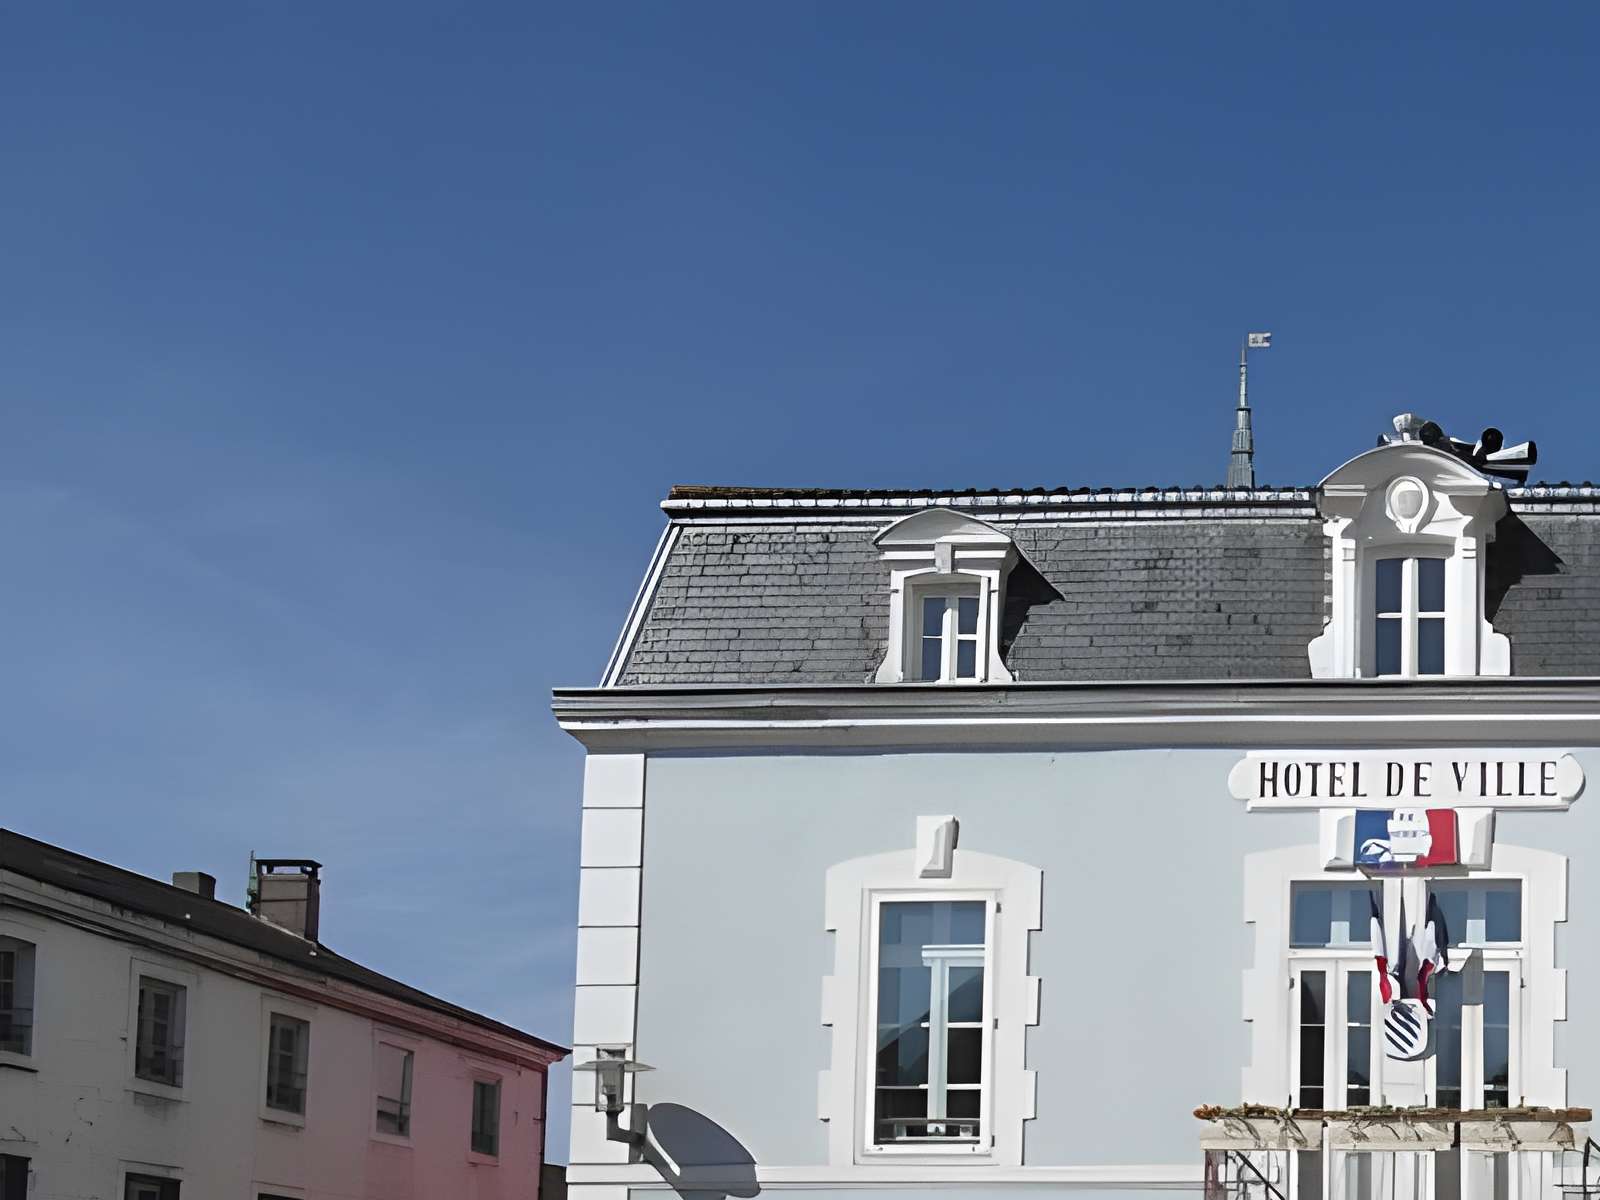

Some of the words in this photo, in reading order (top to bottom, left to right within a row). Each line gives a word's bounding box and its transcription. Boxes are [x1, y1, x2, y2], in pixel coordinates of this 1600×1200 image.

[1259, 760, 1367, 798] HOTEL
[1386, 760, 1433, 798] DE
[1451, 760, 1558, 797] VILLE
